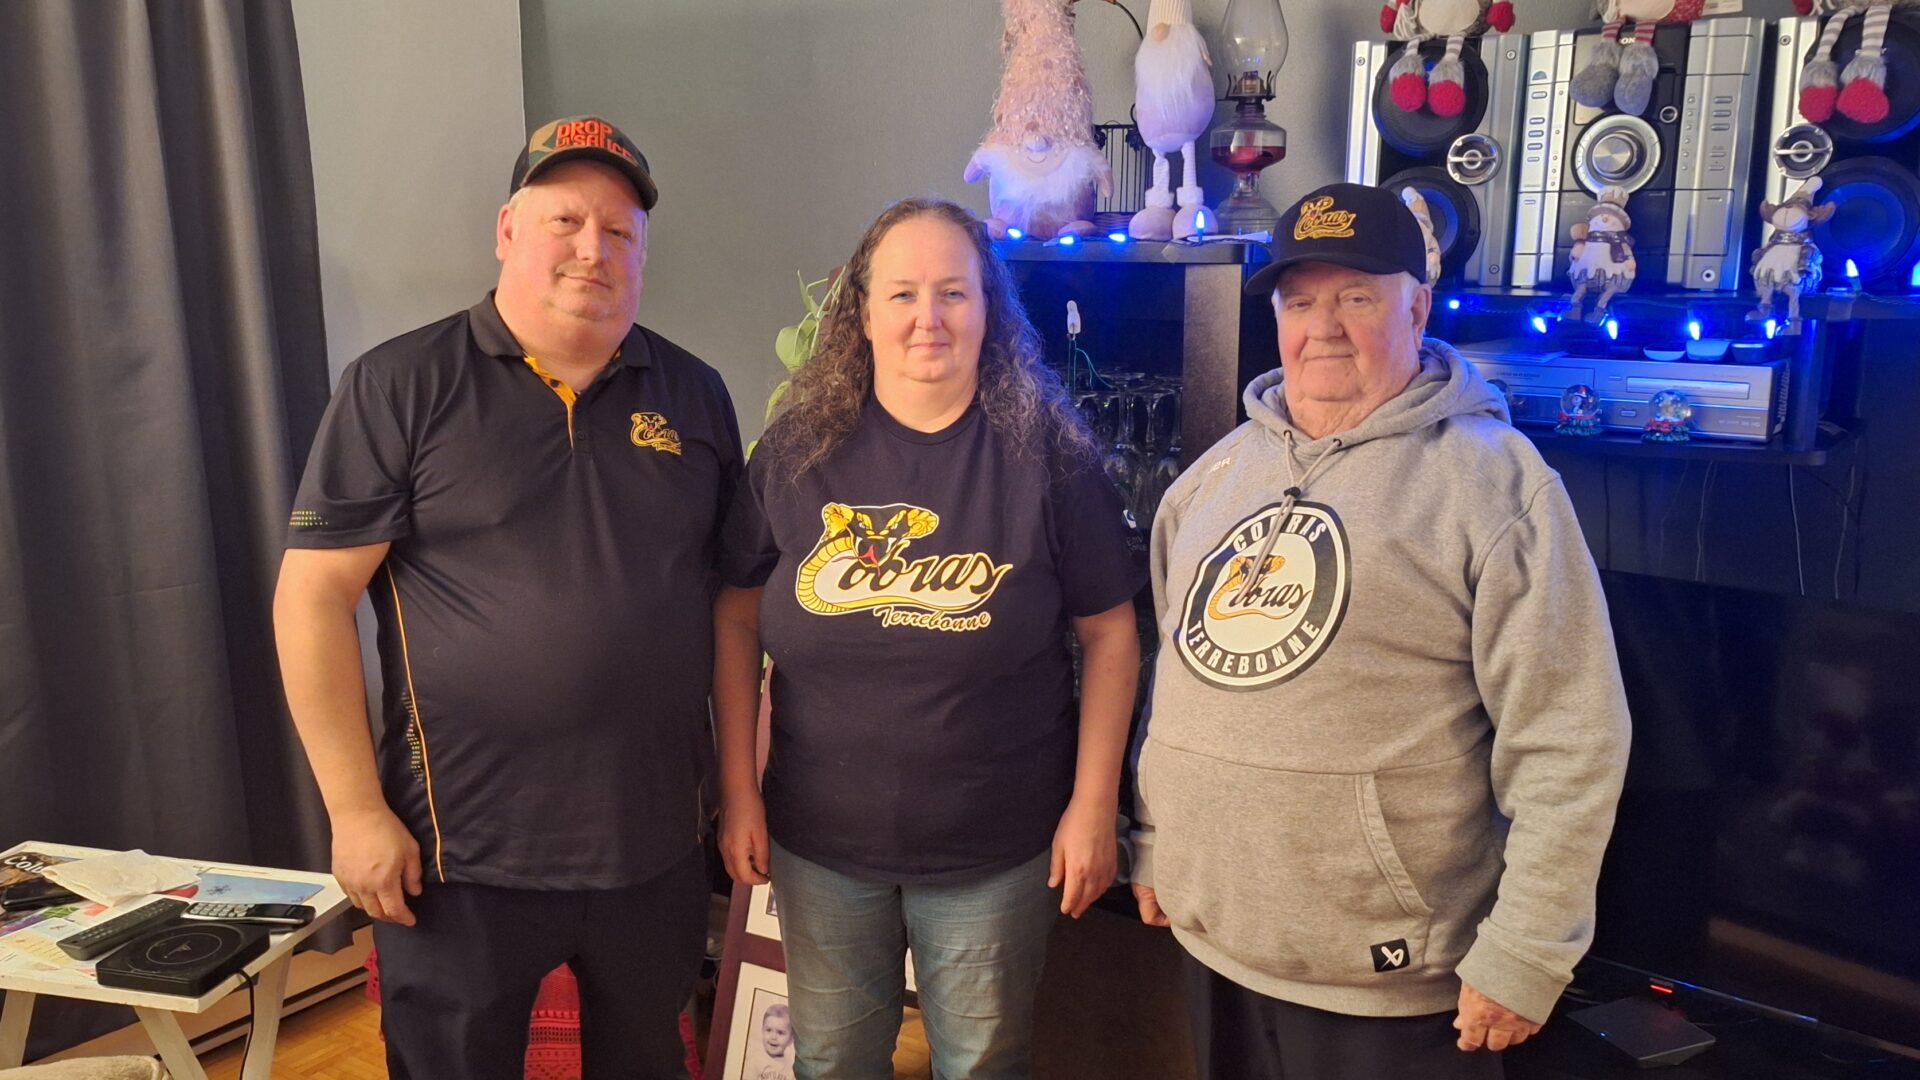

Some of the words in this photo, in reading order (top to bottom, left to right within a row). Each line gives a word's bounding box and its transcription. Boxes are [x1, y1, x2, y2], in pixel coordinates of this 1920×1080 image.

[557, 120, 613, 143] DROP
[1233, 514, 1326, 553] CORAS
[796, 523, 1013, 615] Cobras
[874, 604, 992, 632] Terrebonne
[1187, 619, 1321, 675] TERREBONNE
